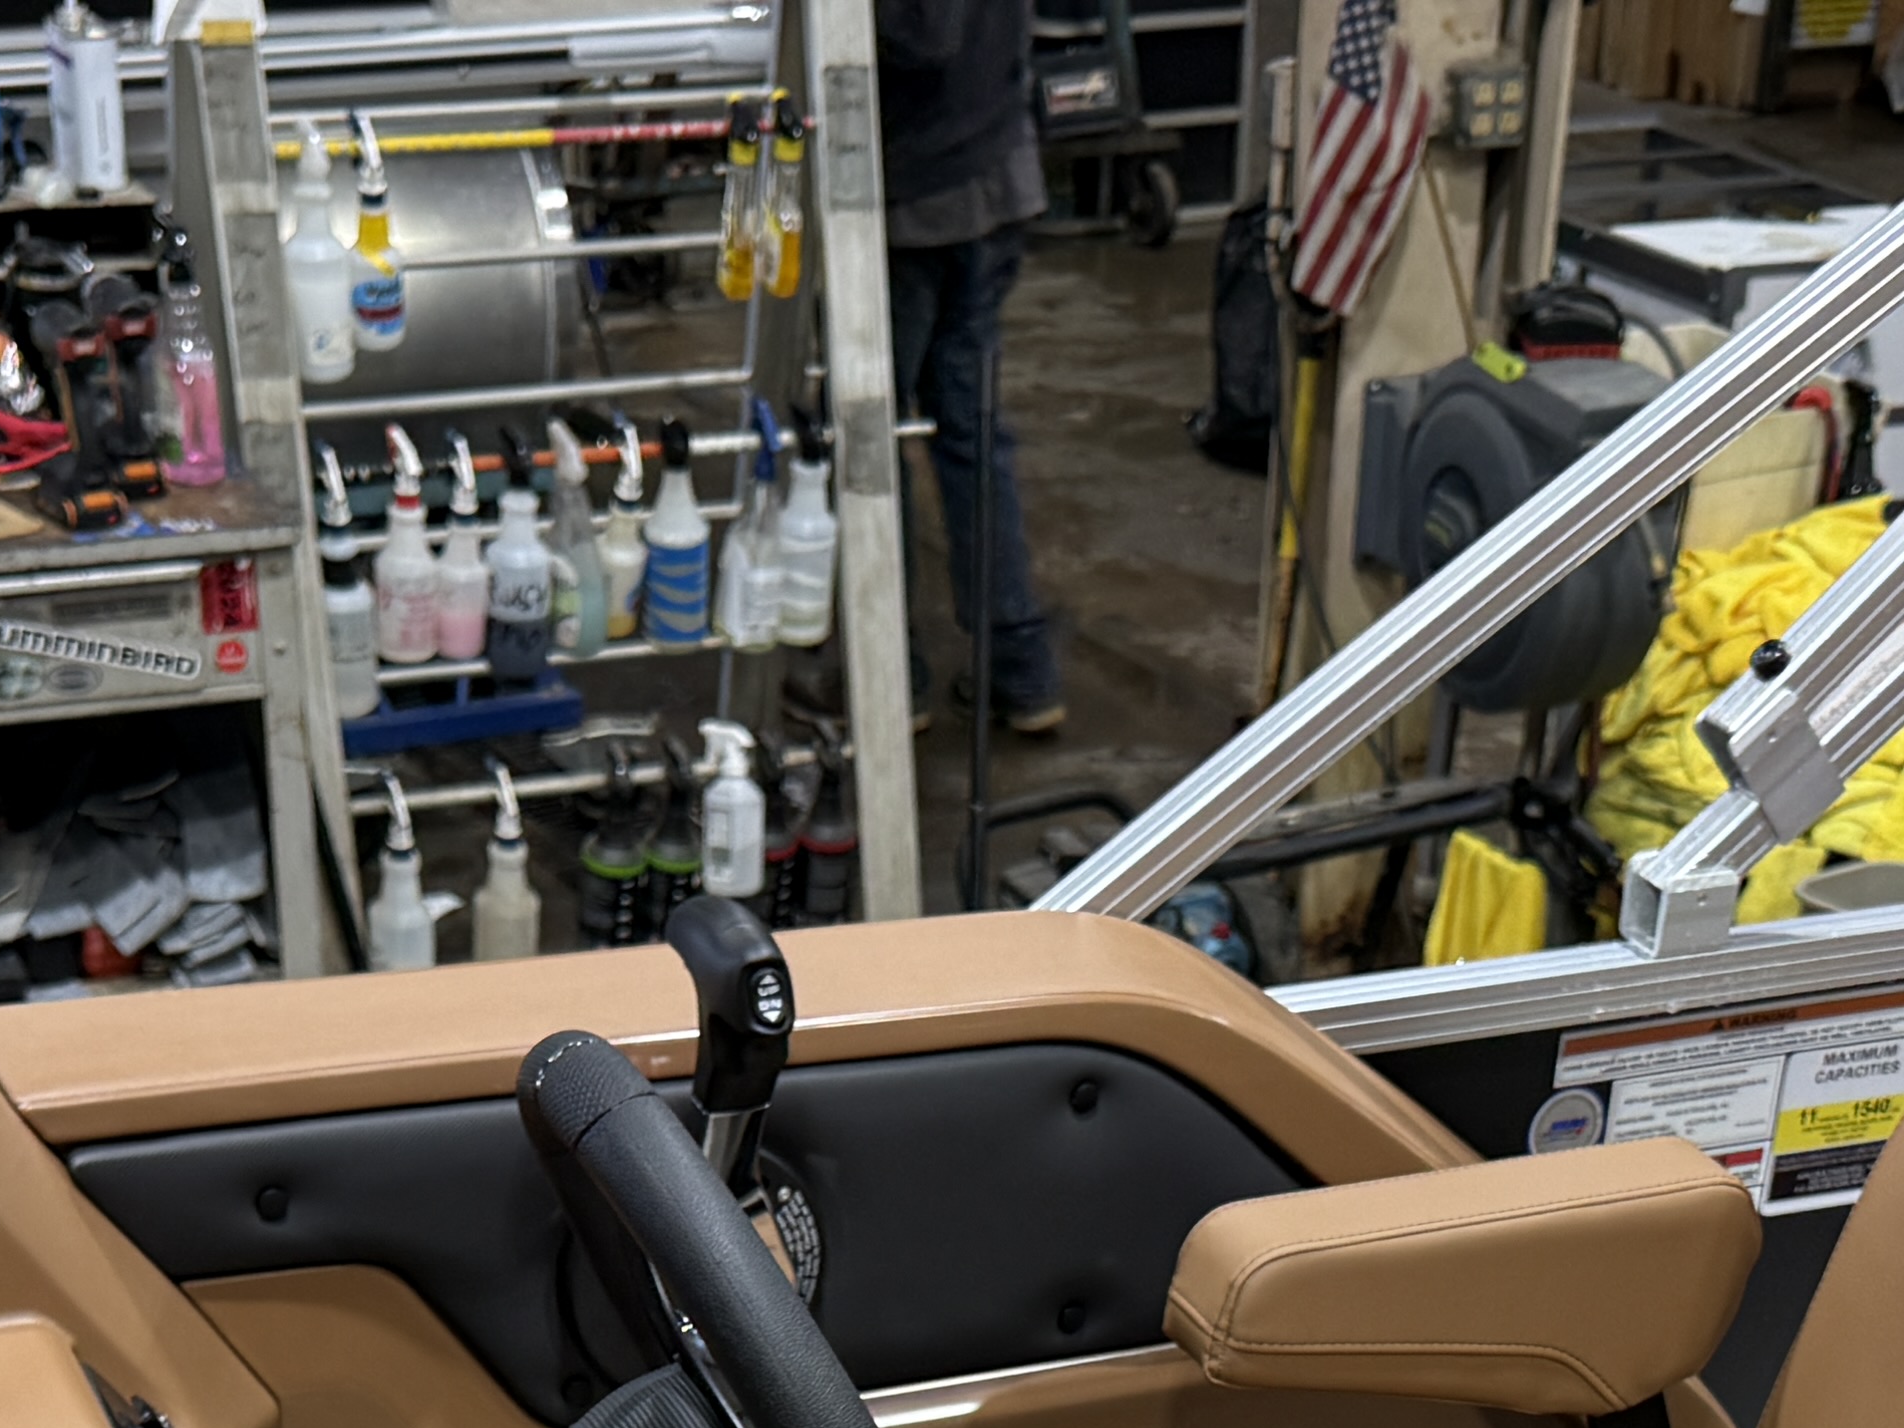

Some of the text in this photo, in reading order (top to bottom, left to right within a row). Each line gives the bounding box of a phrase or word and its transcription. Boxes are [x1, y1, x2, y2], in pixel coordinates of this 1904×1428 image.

[757, 983, 781, 997] UP
[1823, 1044, 1898, 1066] MAXIMUM
[1814, 1060, 1900, 1084] CAPACITIES
